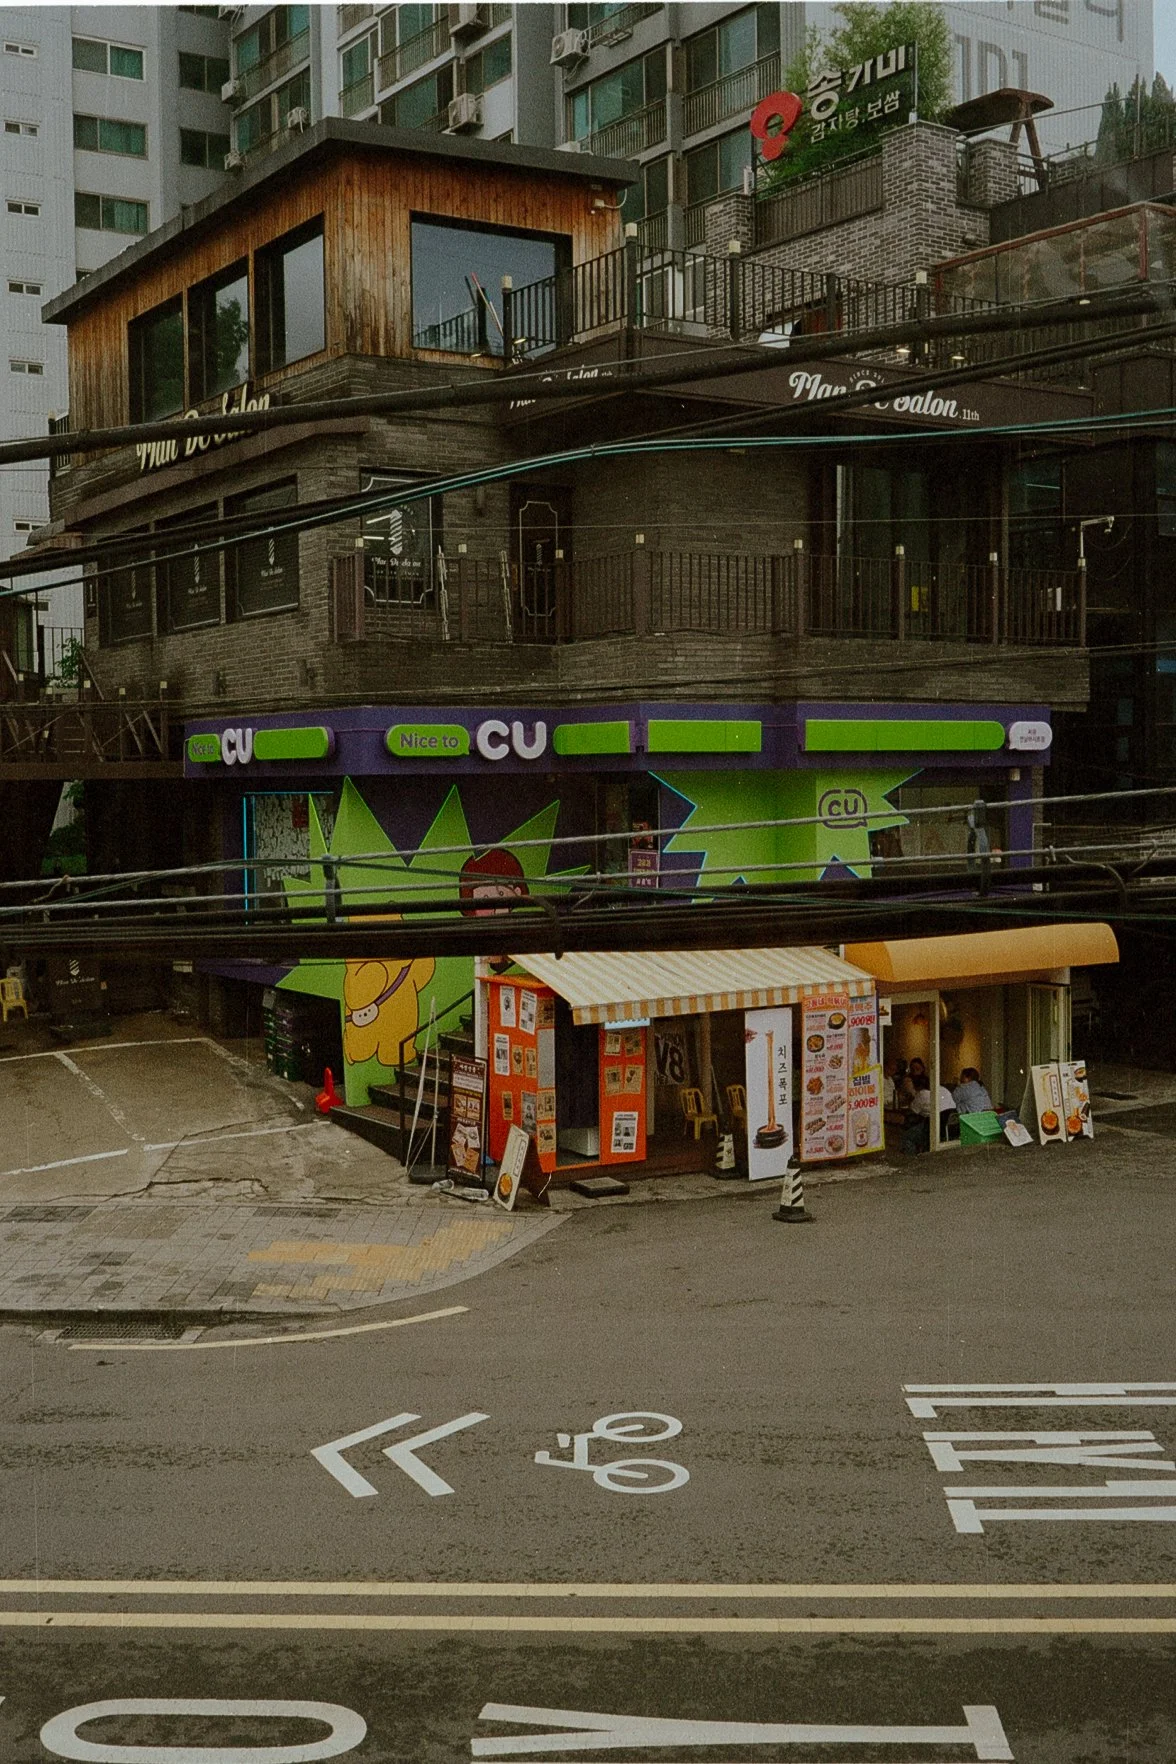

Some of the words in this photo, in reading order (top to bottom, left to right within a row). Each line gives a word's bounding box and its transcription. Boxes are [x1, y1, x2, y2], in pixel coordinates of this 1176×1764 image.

[221, 727, 252, 765] CU
[400, 733, 438, 748] Nice
[442, 733, 459, 748] to
[475, 720, 547, 761] CU
[827, 798, 859, 817] CU
[777, 1045, 788, 1106] 치즈폭포
